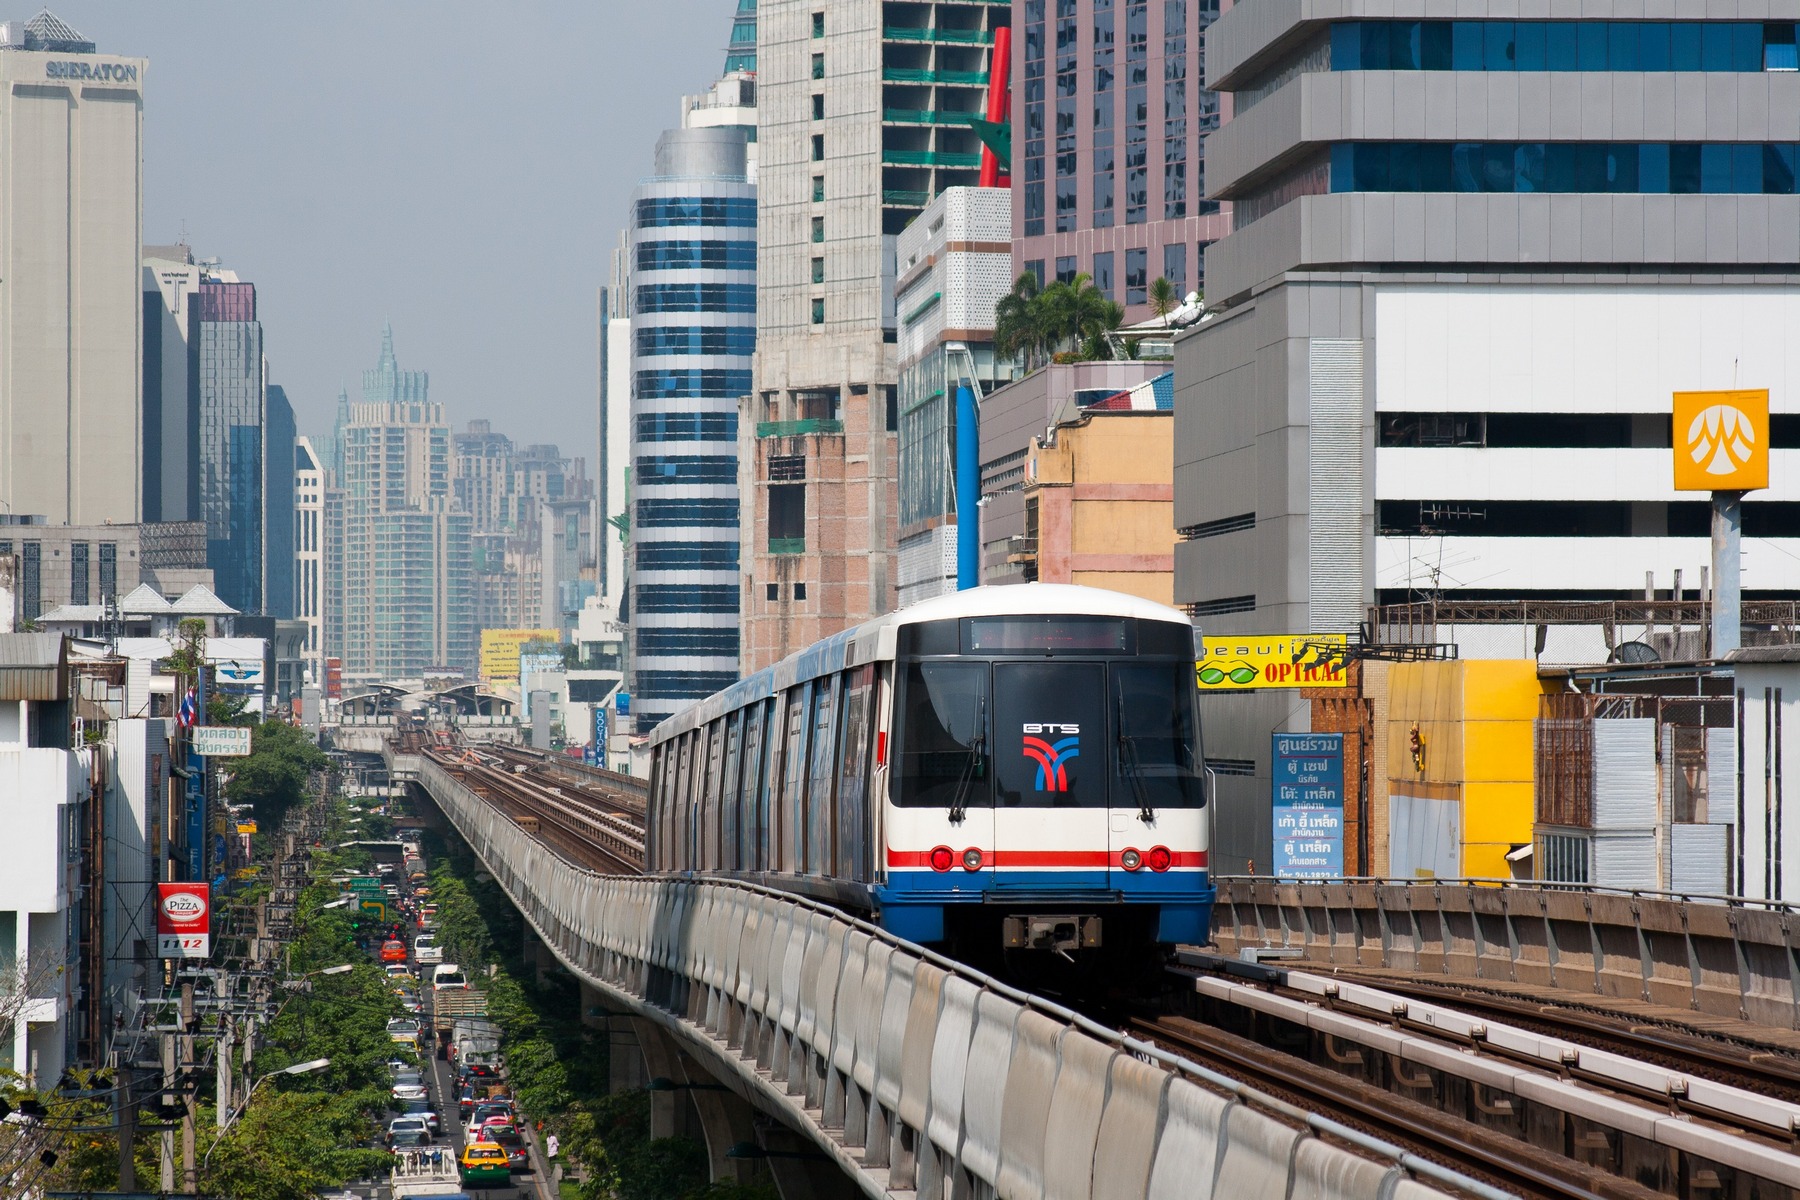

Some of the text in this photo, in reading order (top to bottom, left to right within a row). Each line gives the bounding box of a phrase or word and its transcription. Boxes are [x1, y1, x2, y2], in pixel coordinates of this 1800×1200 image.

[46, 61, 137, 82] SHERATON
[1265, 662, 1342, 683] OPTICAL
[198, 729, 247, 739] ทดสอบ
[1023, 723, 1080, 734] BTS
[1278, 736, 1338, 754] ศูนย์รวม
[1288, 759, 1298, 774] ตู้
[1304, 786, 1336, 800] เหล็ก
[1309, 814, 1338, 828] เหล็ก
[1284, 839, 1331, 855] ตู้ เหล็ก
[170, 901, 199, 910] PIZZA
[163, 939, 203, 949] 1112
